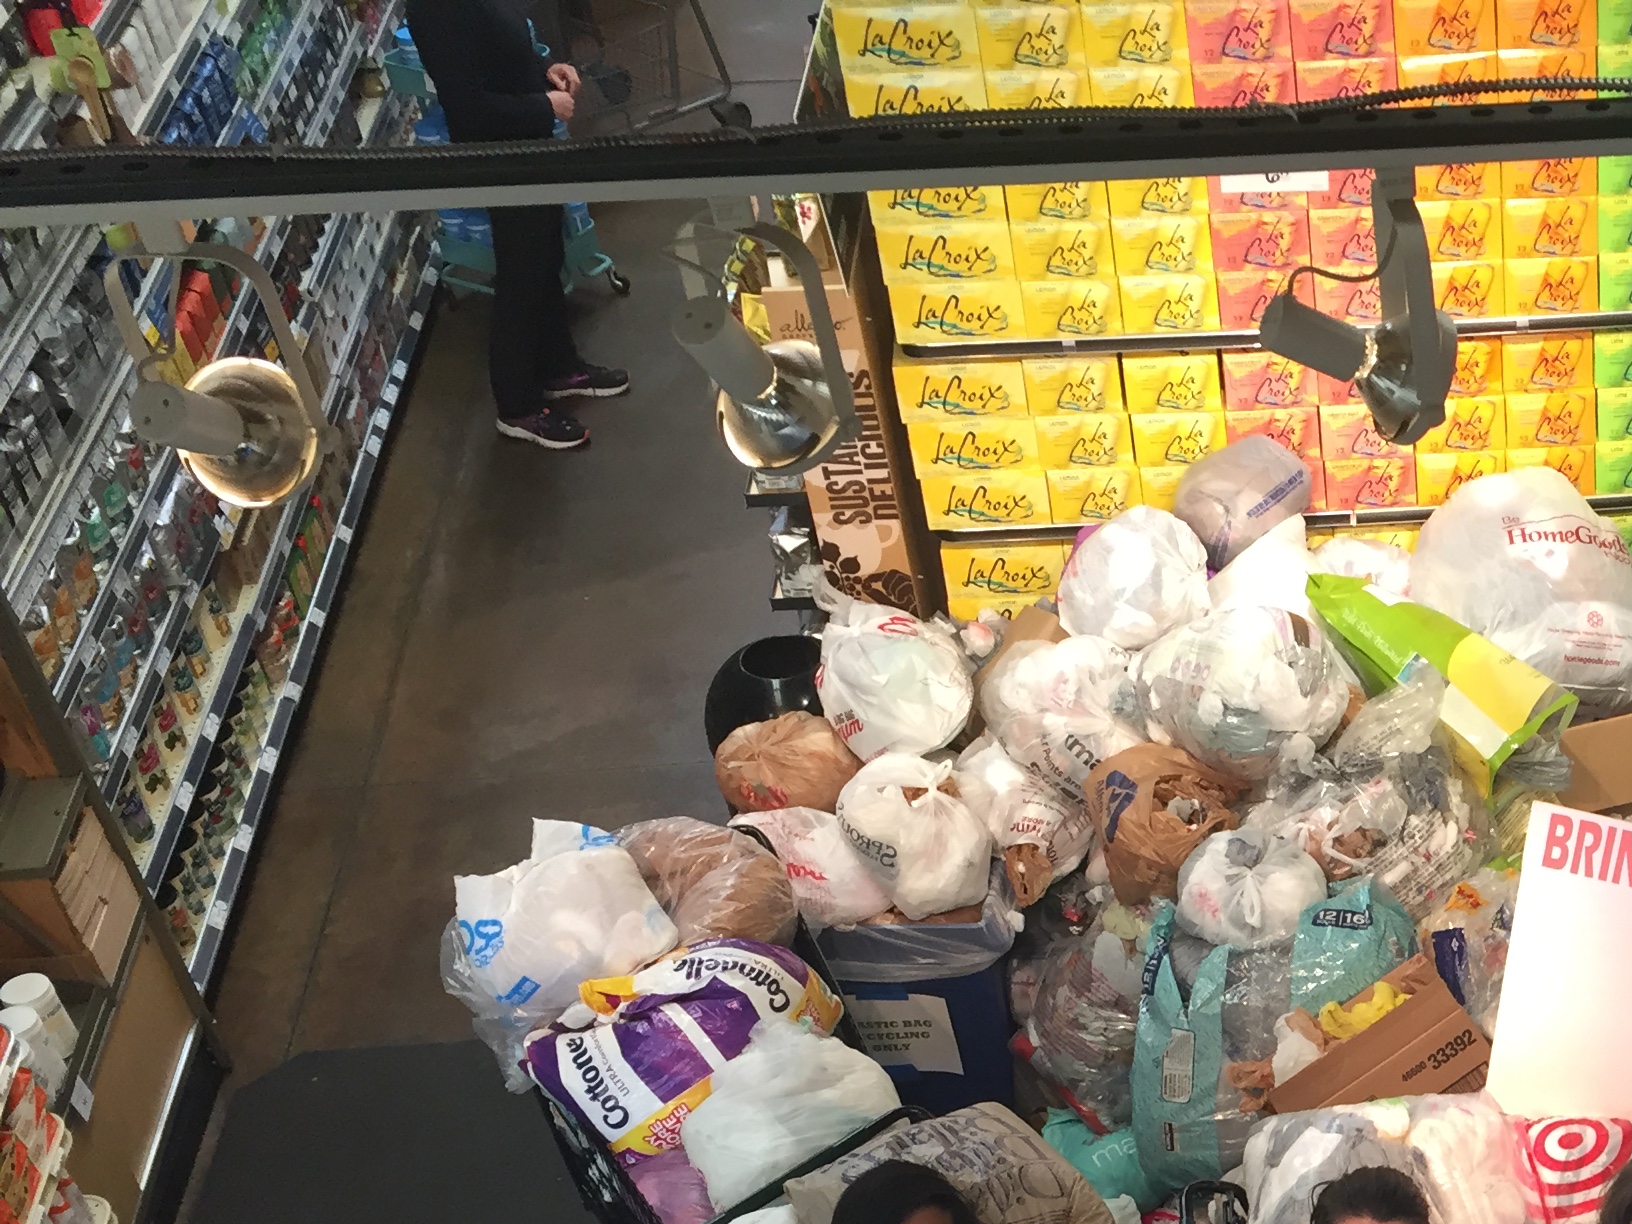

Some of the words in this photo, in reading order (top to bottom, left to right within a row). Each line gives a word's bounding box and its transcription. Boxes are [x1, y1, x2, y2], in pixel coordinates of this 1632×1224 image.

[1036, 13, 1056, 40] La
[1140, 10, 1161, 37] La
[1242, 7, 1265, 35] La
[1347, 3, 1368, 30] La
[858, 17, 953, 62] LaCroix
[1119, 29, 1168, 60] Croix
[1223, 26, 1272, 56] Croix
[1325, 23, 1373, 53] Croix
[1429, 17, 1476, 48] Croix
[1014, 32, 1064, 63] Croix
[1266, 217, 1284, 246] La
[1460, 208, 1477, 234] La
[1556, 206, 1573, 232] La
[1069, 230, 1087, 253] La
[1167, 224, 1186, 249] La
[1438, 226, 1483, 256] Croix
[1534, 224, 1580, 253] Croix
[900, 235, 989, 274] LaCroix
[1046, 247, 1094, 274] Croix
[1146, 241, 1192, 270] Croix
[1244, 238, 1290, 266] Croix
[1557, 266, 1575, 291] La
[1078, 289, 1097, 312] La
[1175, 283, 1194, 307] La
[1535, 282, 1580, 310] Croix
[913, 295, 1001, 334] LaCroix
[1058, 306, 1104, 332] Croix
[1154, 300, 1200, 326] Croix
[1552, 341, 1570, 365] La
[1076, 366, 1095, 388] La
[1176, 366, 1196, 389] La
[1275, 361, 1294, 384] La
[1531, 358, 1574, 385] Croix
[916, 375, 1003, 413] LaCroix
[1058, 383, 1102, 409] Croix
[1158, 383, 1202, 408] Croix
[1256, 378, 1300, 404] Croix
[1465, 406, 1482, 428] La
[1555, 401, 1572, 424] La
[1089, 422, 1107, 443] La
[1185, 420, 1203, 443] La
[1446, 422, 1489, 448] Croix
[1536, 417, 1579, 442] Croix
[931, 431, 1016, 468] LaCroix
[1070, 438, 1114, 463] Croix
[1166, 436, 1209, 462] Croix
[1099, 476, 1118, 498] La
[1376, 462, 1394, 487] La
[943, 485, 1026, 521] LaCroix
[1081, 493, 1124, 518] Croix
[1356, 480, 1399, 505] Croix
[963, 558, 1044, 591] LaCroix
[1318, 910, 1336, 921] 12
[902, 1020, 932, 1028] BAG
[873, 1043, 912, 1052] ONLY
[1428, 1028, 1477, 1070] 33392
[608, 1068, 630, 1097] ULTRA
